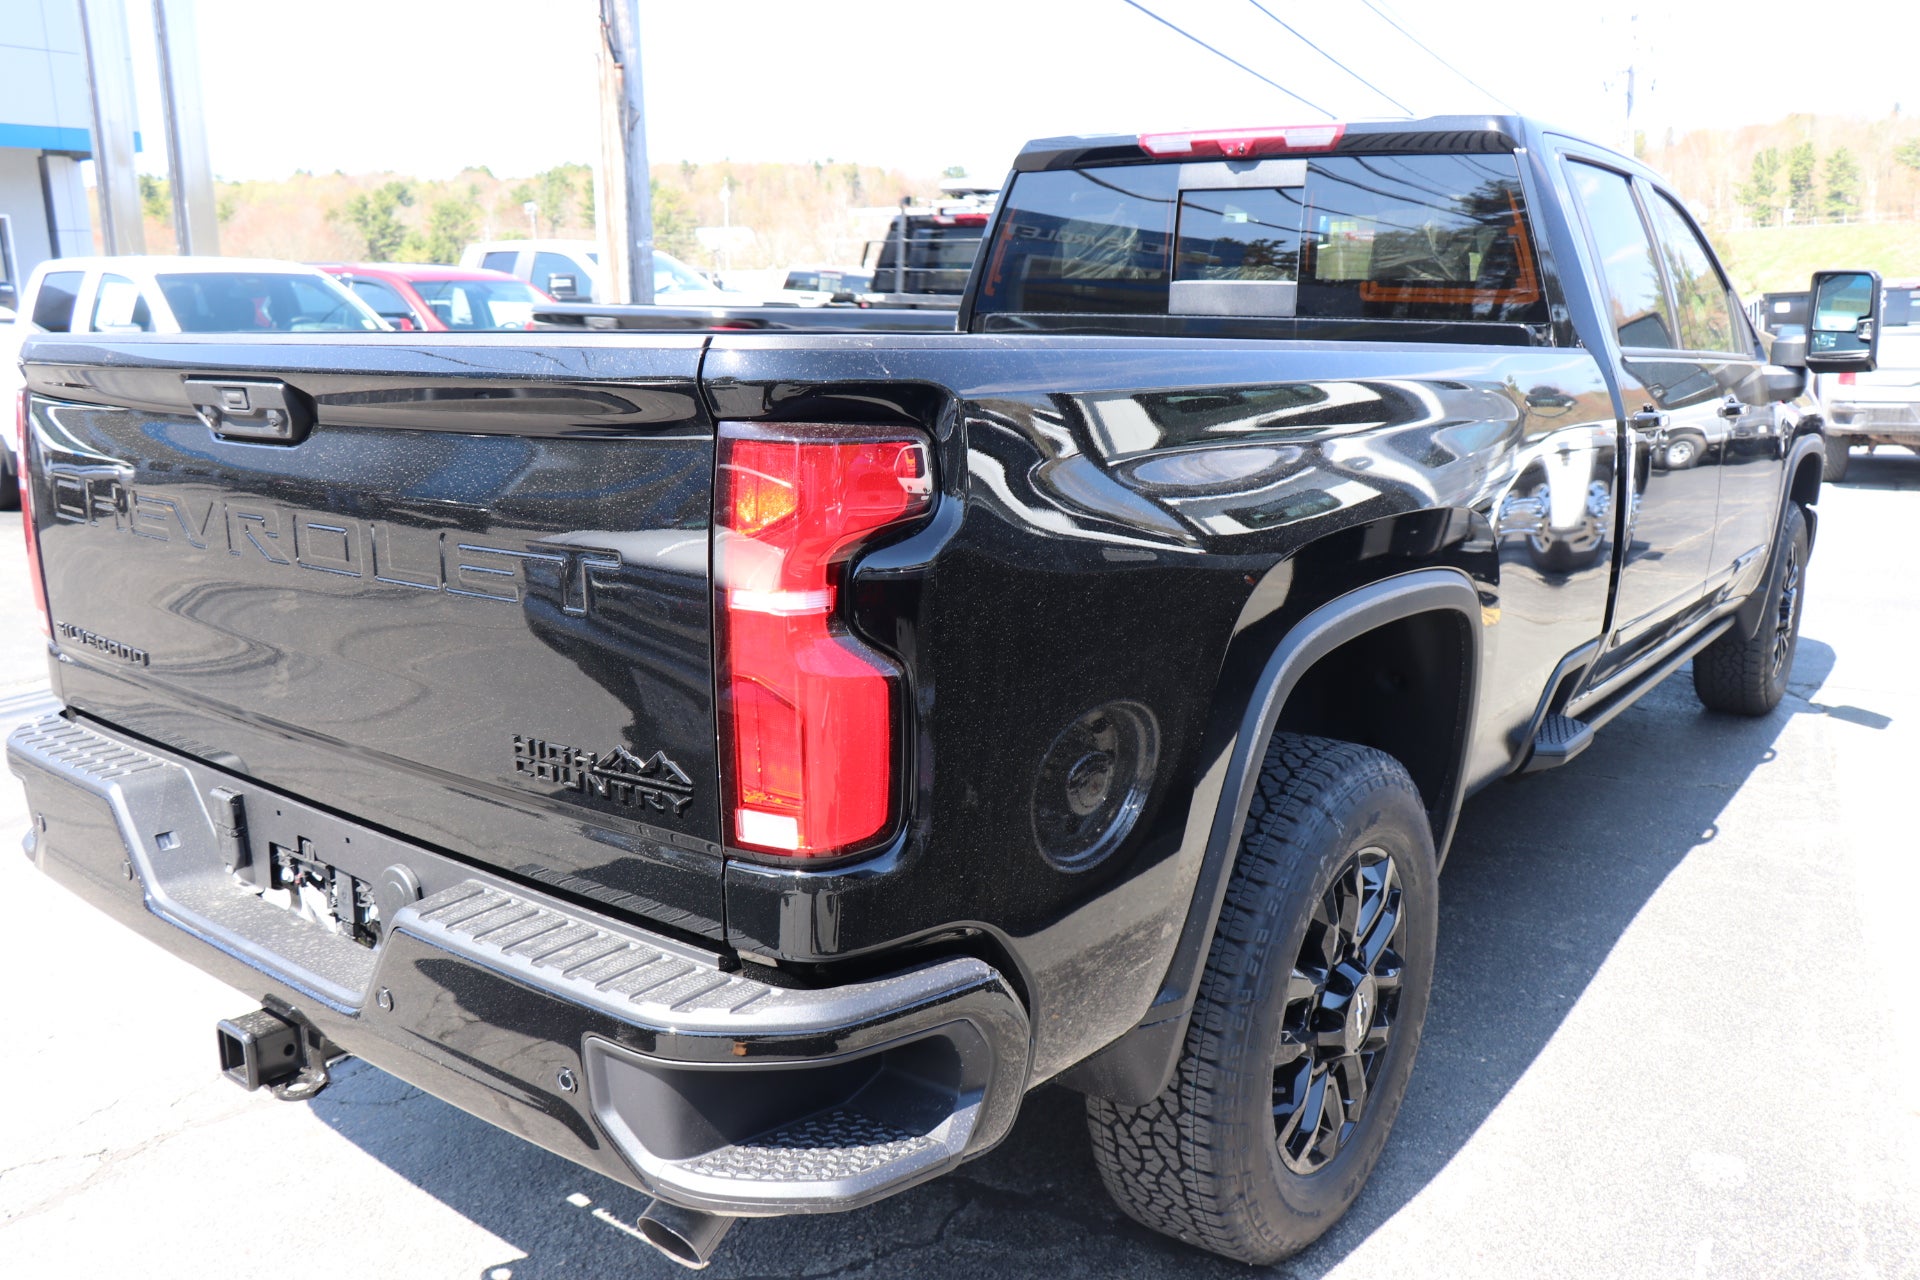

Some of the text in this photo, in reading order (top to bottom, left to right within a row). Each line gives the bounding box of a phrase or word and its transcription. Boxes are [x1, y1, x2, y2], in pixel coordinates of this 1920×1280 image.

[53, 472, 623, 616] CHEVROLET
[512, 734, 599, 772] HIGH
[516, 756, 694, 819] COUNTRY
